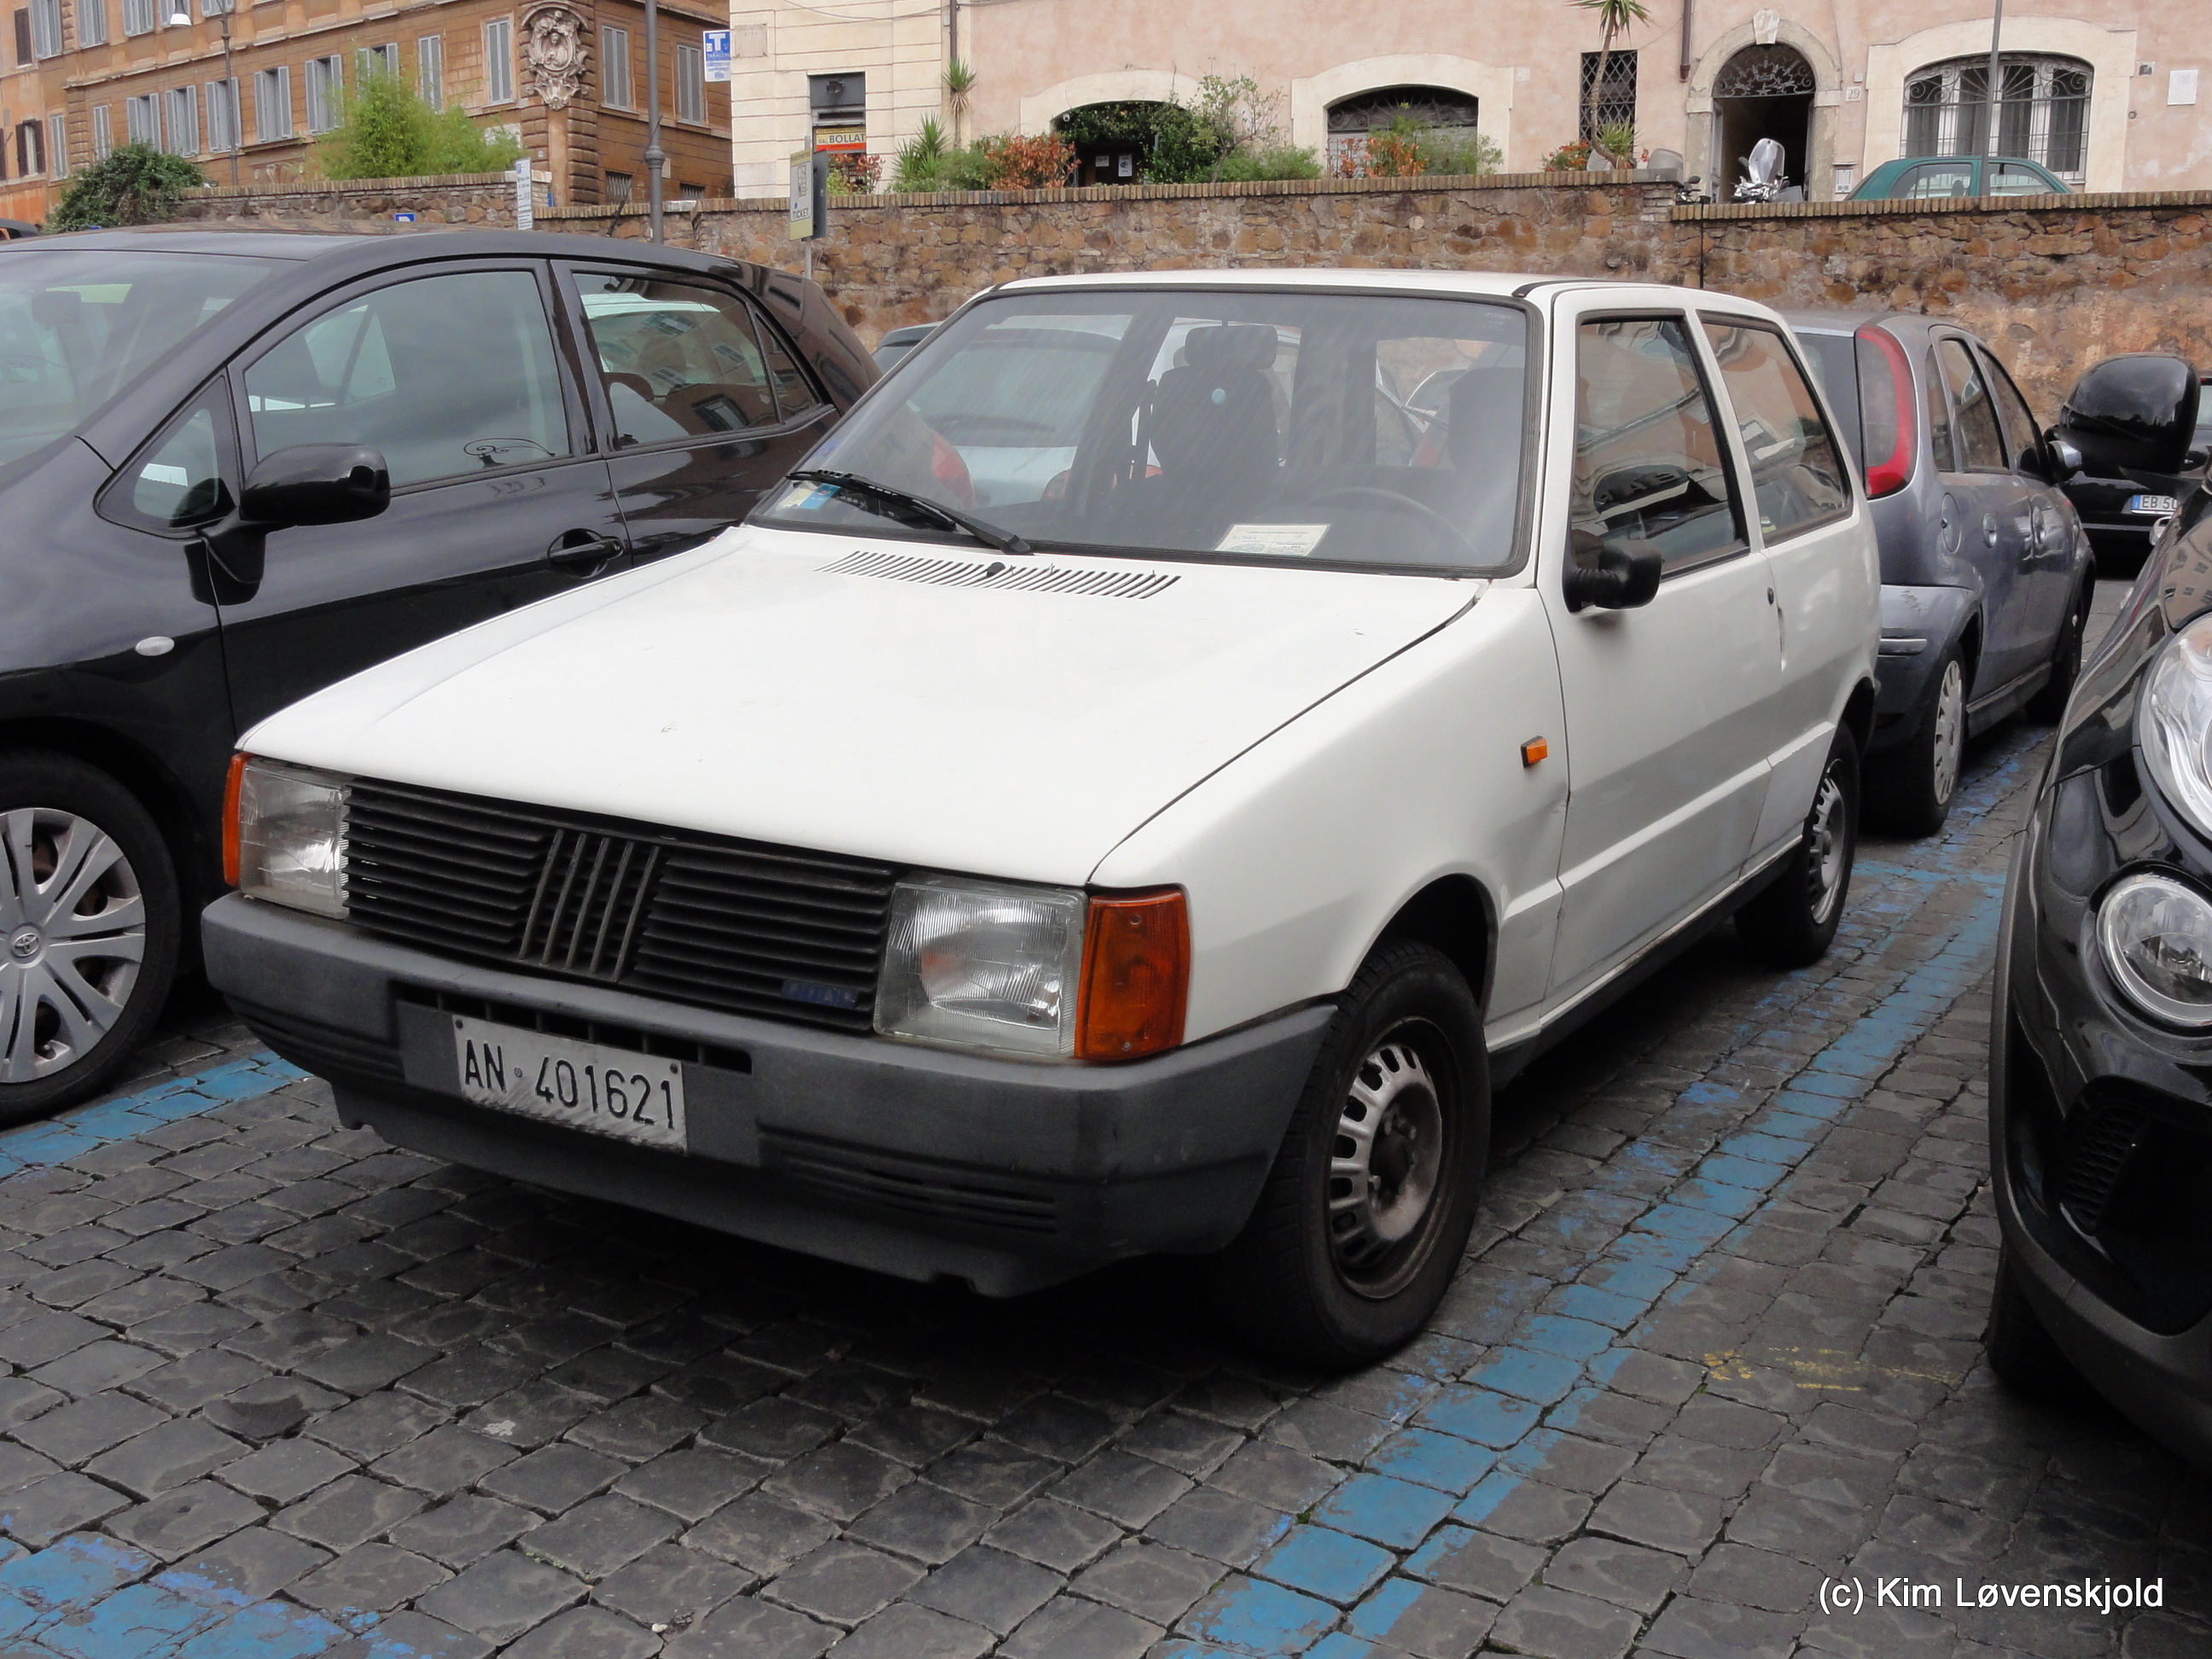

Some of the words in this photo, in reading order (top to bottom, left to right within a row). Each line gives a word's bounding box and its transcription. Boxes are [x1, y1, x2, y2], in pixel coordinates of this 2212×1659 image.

[708, 32, 725, 51] T
[1848, 88, 1860, 100] 29
[793, 207, 810, 220] TICKET
[2142, 496, 2158, 509] EB
[465, 1039, 507, 1092] AN
[535, 1057, 674, 1130] 401621
